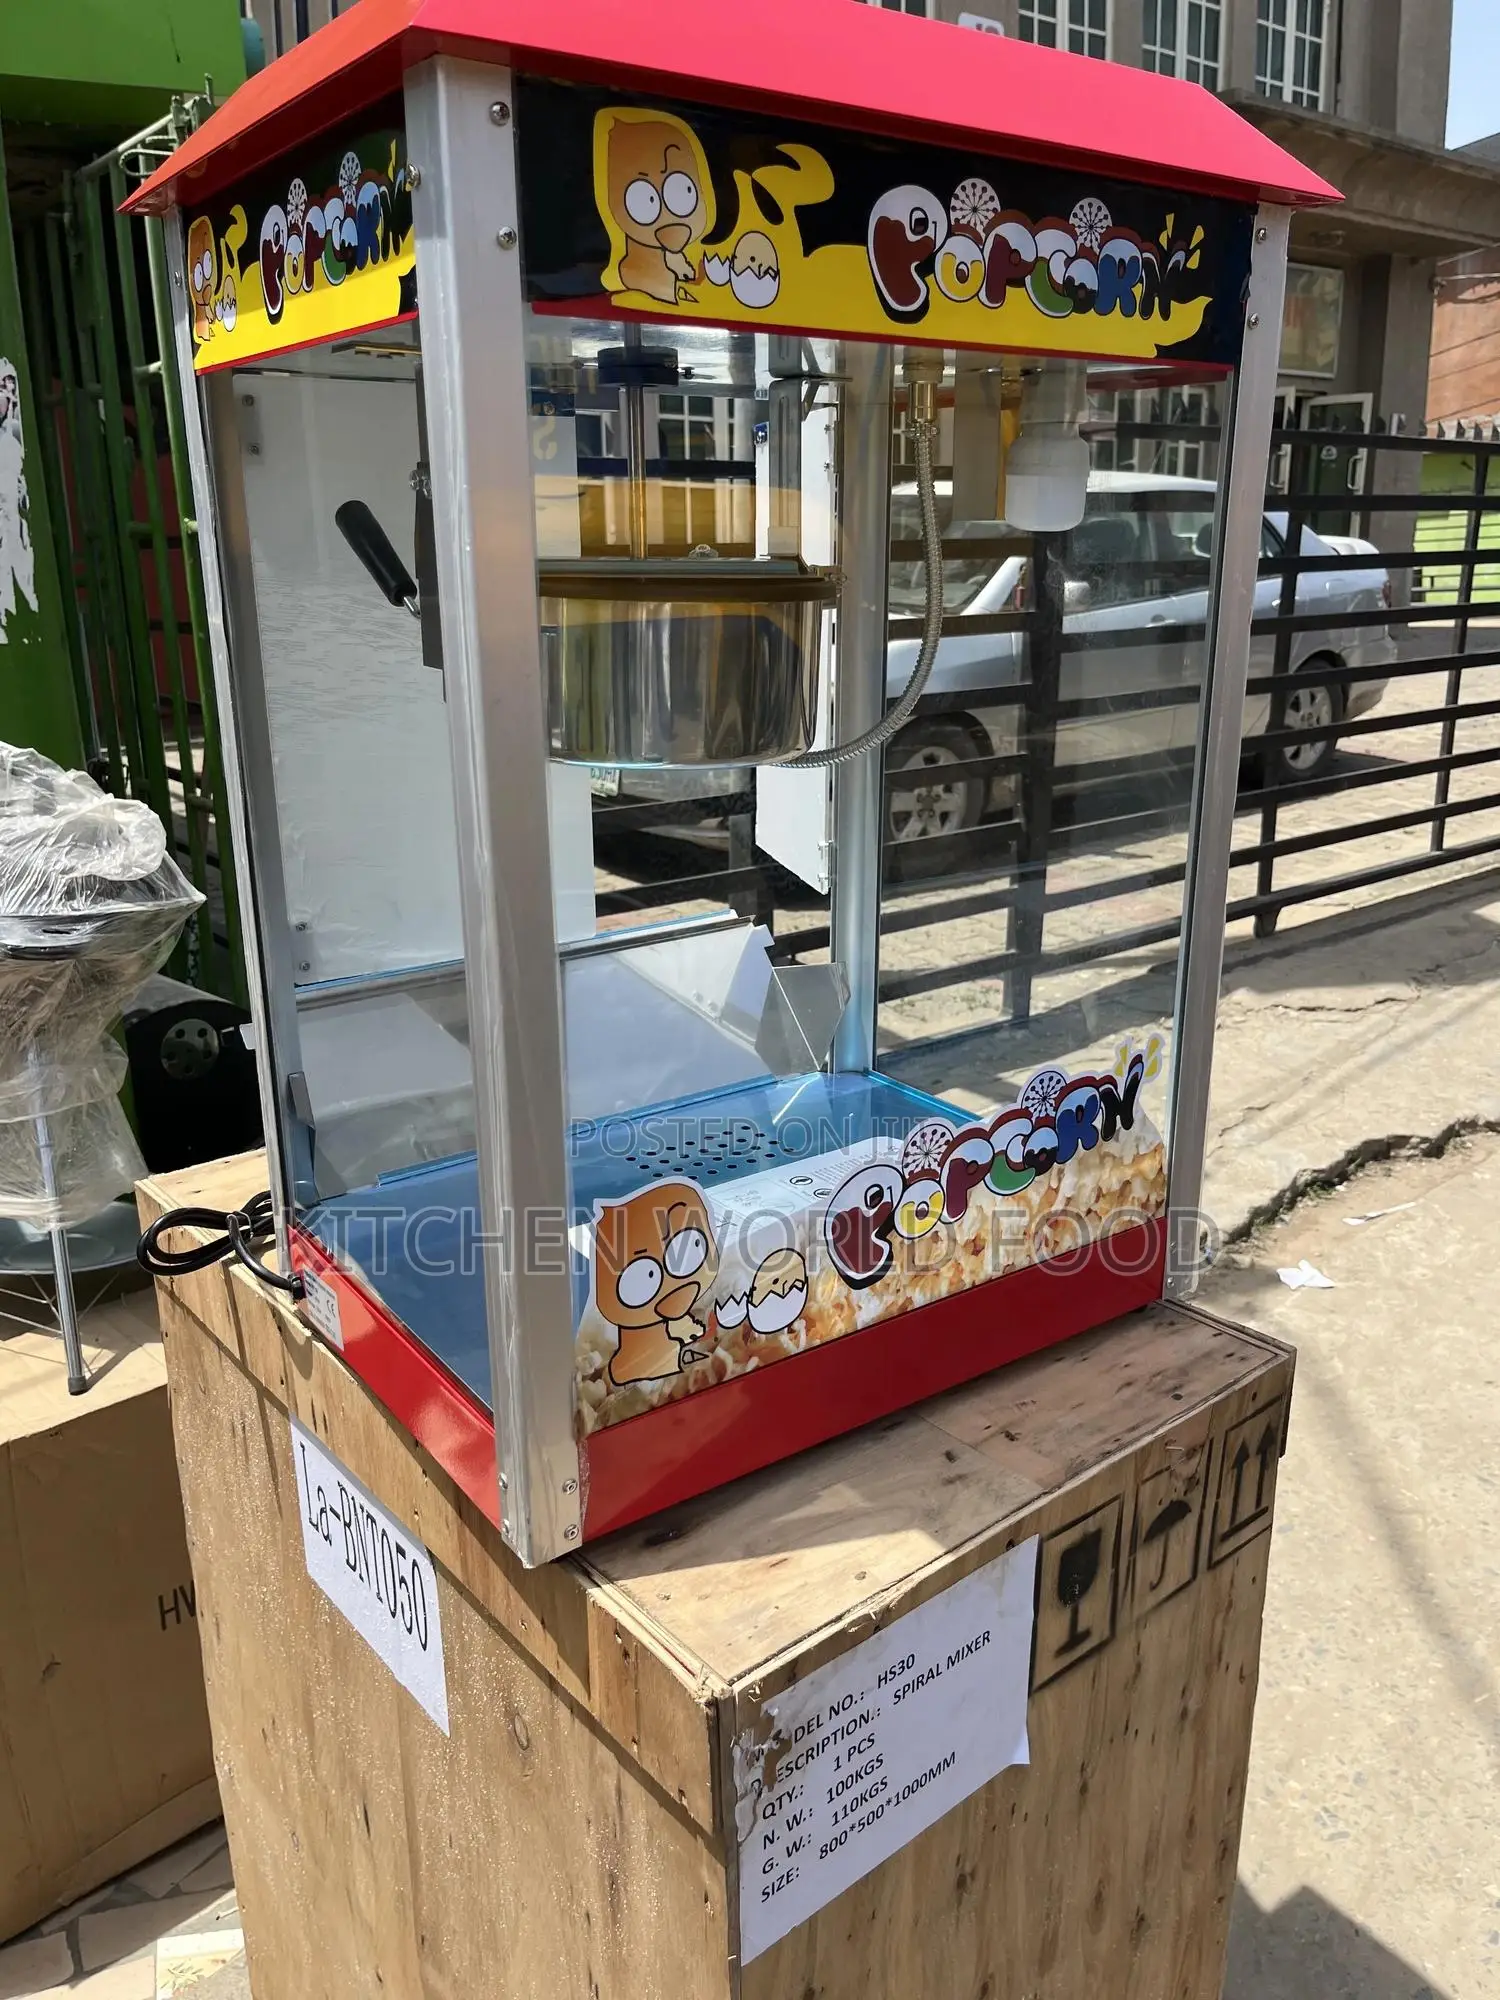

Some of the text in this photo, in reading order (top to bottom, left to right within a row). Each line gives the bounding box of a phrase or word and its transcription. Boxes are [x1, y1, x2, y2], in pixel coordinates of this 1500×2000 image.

[867, 182, 1190, 324] POPCORN
[824, 1053, 1145, 1291] POPCORN
[828, 1690, 865, 1721] NO.:
[877, 1653, 916, 1690] HS30
[893, 1665, 943, 1705] SPIRAL
[946, 1630, 991, 1670] MIXER
[762, 1733, 876, 1820] QTY.: 1 PCS
[827, 1753, 885, 1804] 100KGS
[831, 1776, 889, 1827] 110KGS
[761, 1866, 801, 1903] SIZE:
